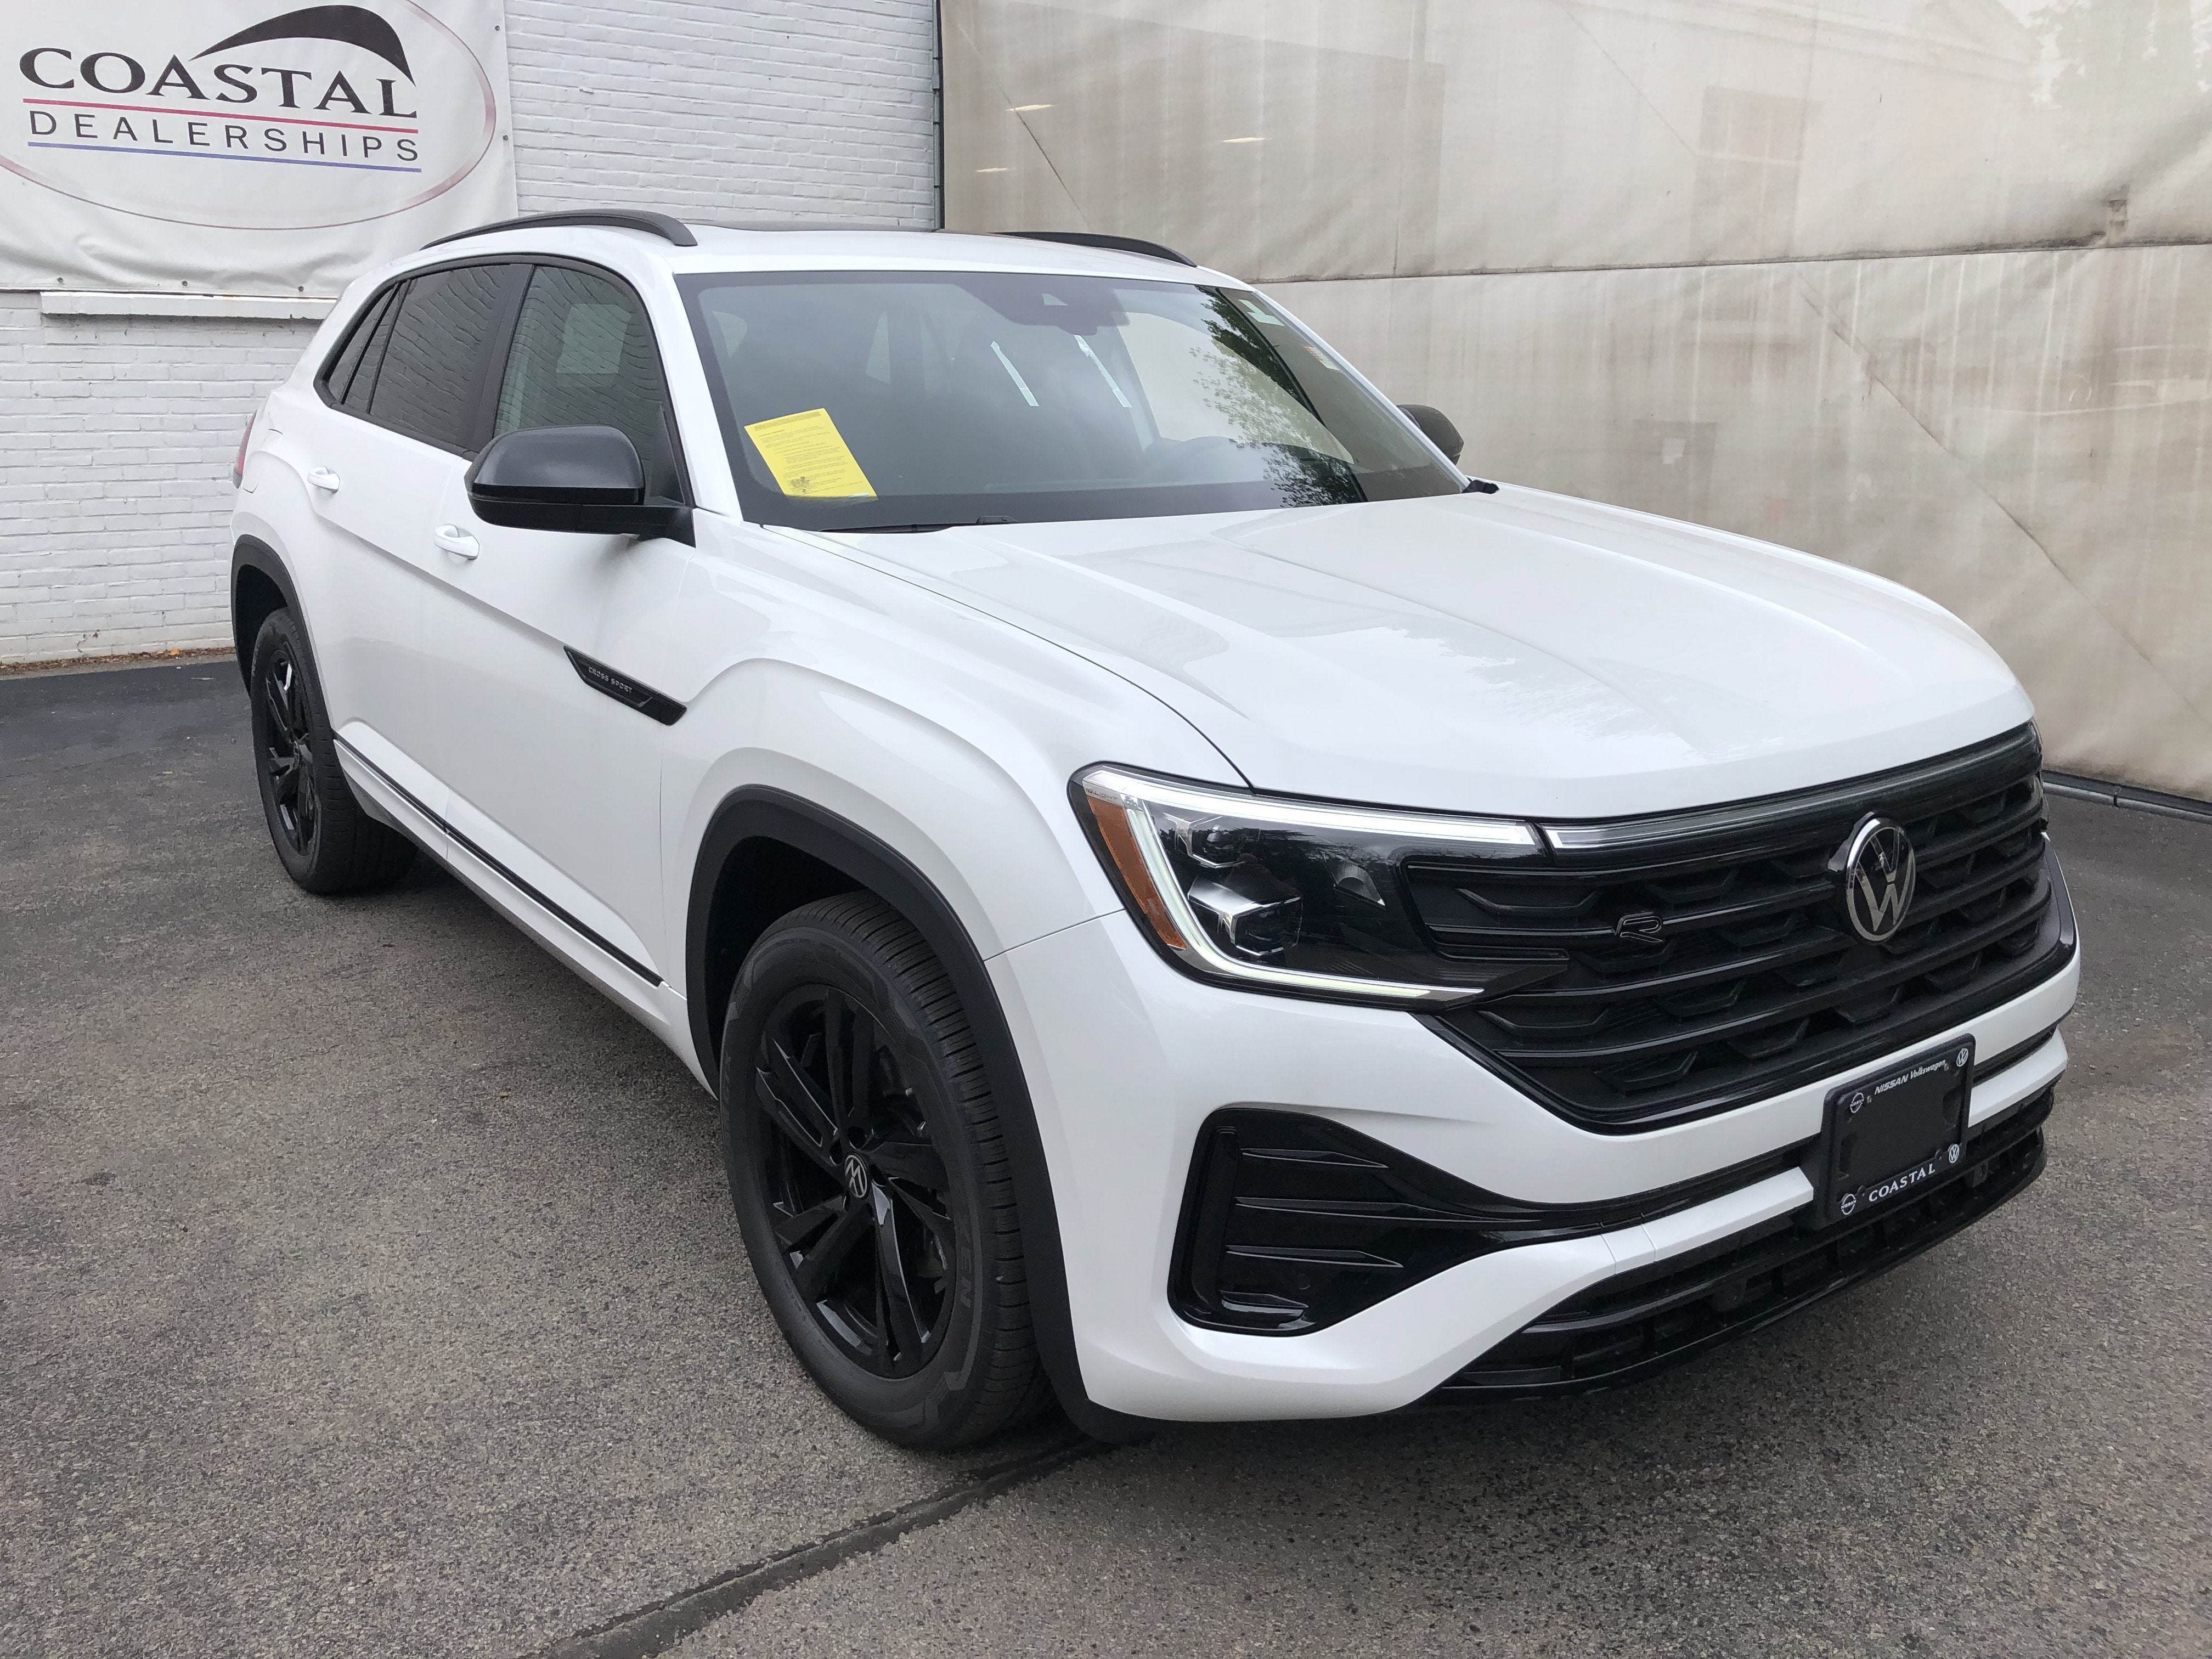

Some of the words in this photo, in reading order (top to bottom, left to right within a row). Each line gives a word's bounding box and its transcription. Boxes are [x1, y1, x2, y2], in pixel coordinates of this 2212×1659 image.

[19, 48, 417, 119] COASTAL
[30, 110, 418, 162] DEALERSHIPS
[588, 667, 609, 682] CROSS
[611, 678, 633, 693] SPORT
[1874, 1074, 1909, 1095] NISSAN
[1869, 1163, 1936, 1201] COASTAL
